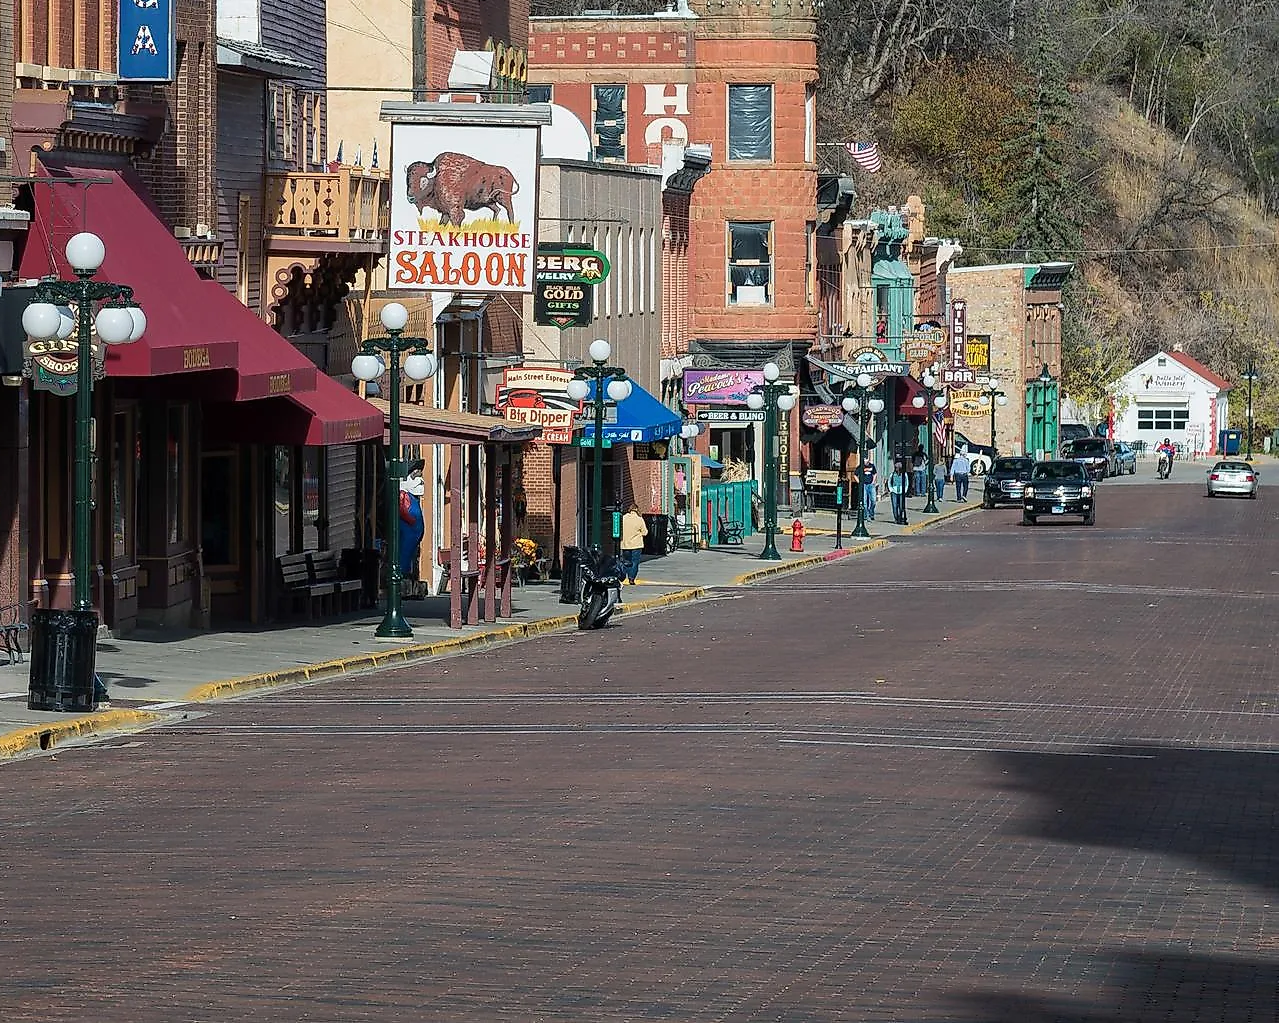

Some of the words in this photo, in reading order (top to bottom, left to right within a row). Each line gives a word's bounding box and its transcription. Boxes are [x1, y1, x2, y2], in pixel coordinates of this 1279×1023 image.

[393, 230, 531, 249] STEAKHOUSE
[395, 250, 528, 288] SALOON
[543, 290, 584, 300] GOLD
[954, 302, 964, 333] WILD
[183, 347, 210, 369] BODEGA
[954, 336, 963, 368] BILL
[524, 373, 544, 381] Street
[687, 373, 742, 397] Peacock's
[944, 371, 973, 382] BAR
[510, 408, 527, 423] Big
[530, 409, 568, 426] Dipper
[708, 411, 729, 420] BEER
[730, 411, 737, 420] &
[740, 411, 764, 420] BLING
[547, 433, 569, 442] CREAM
[580, 438, 592, 447] Gold
[780, 435, 789, 483] HOTEL
